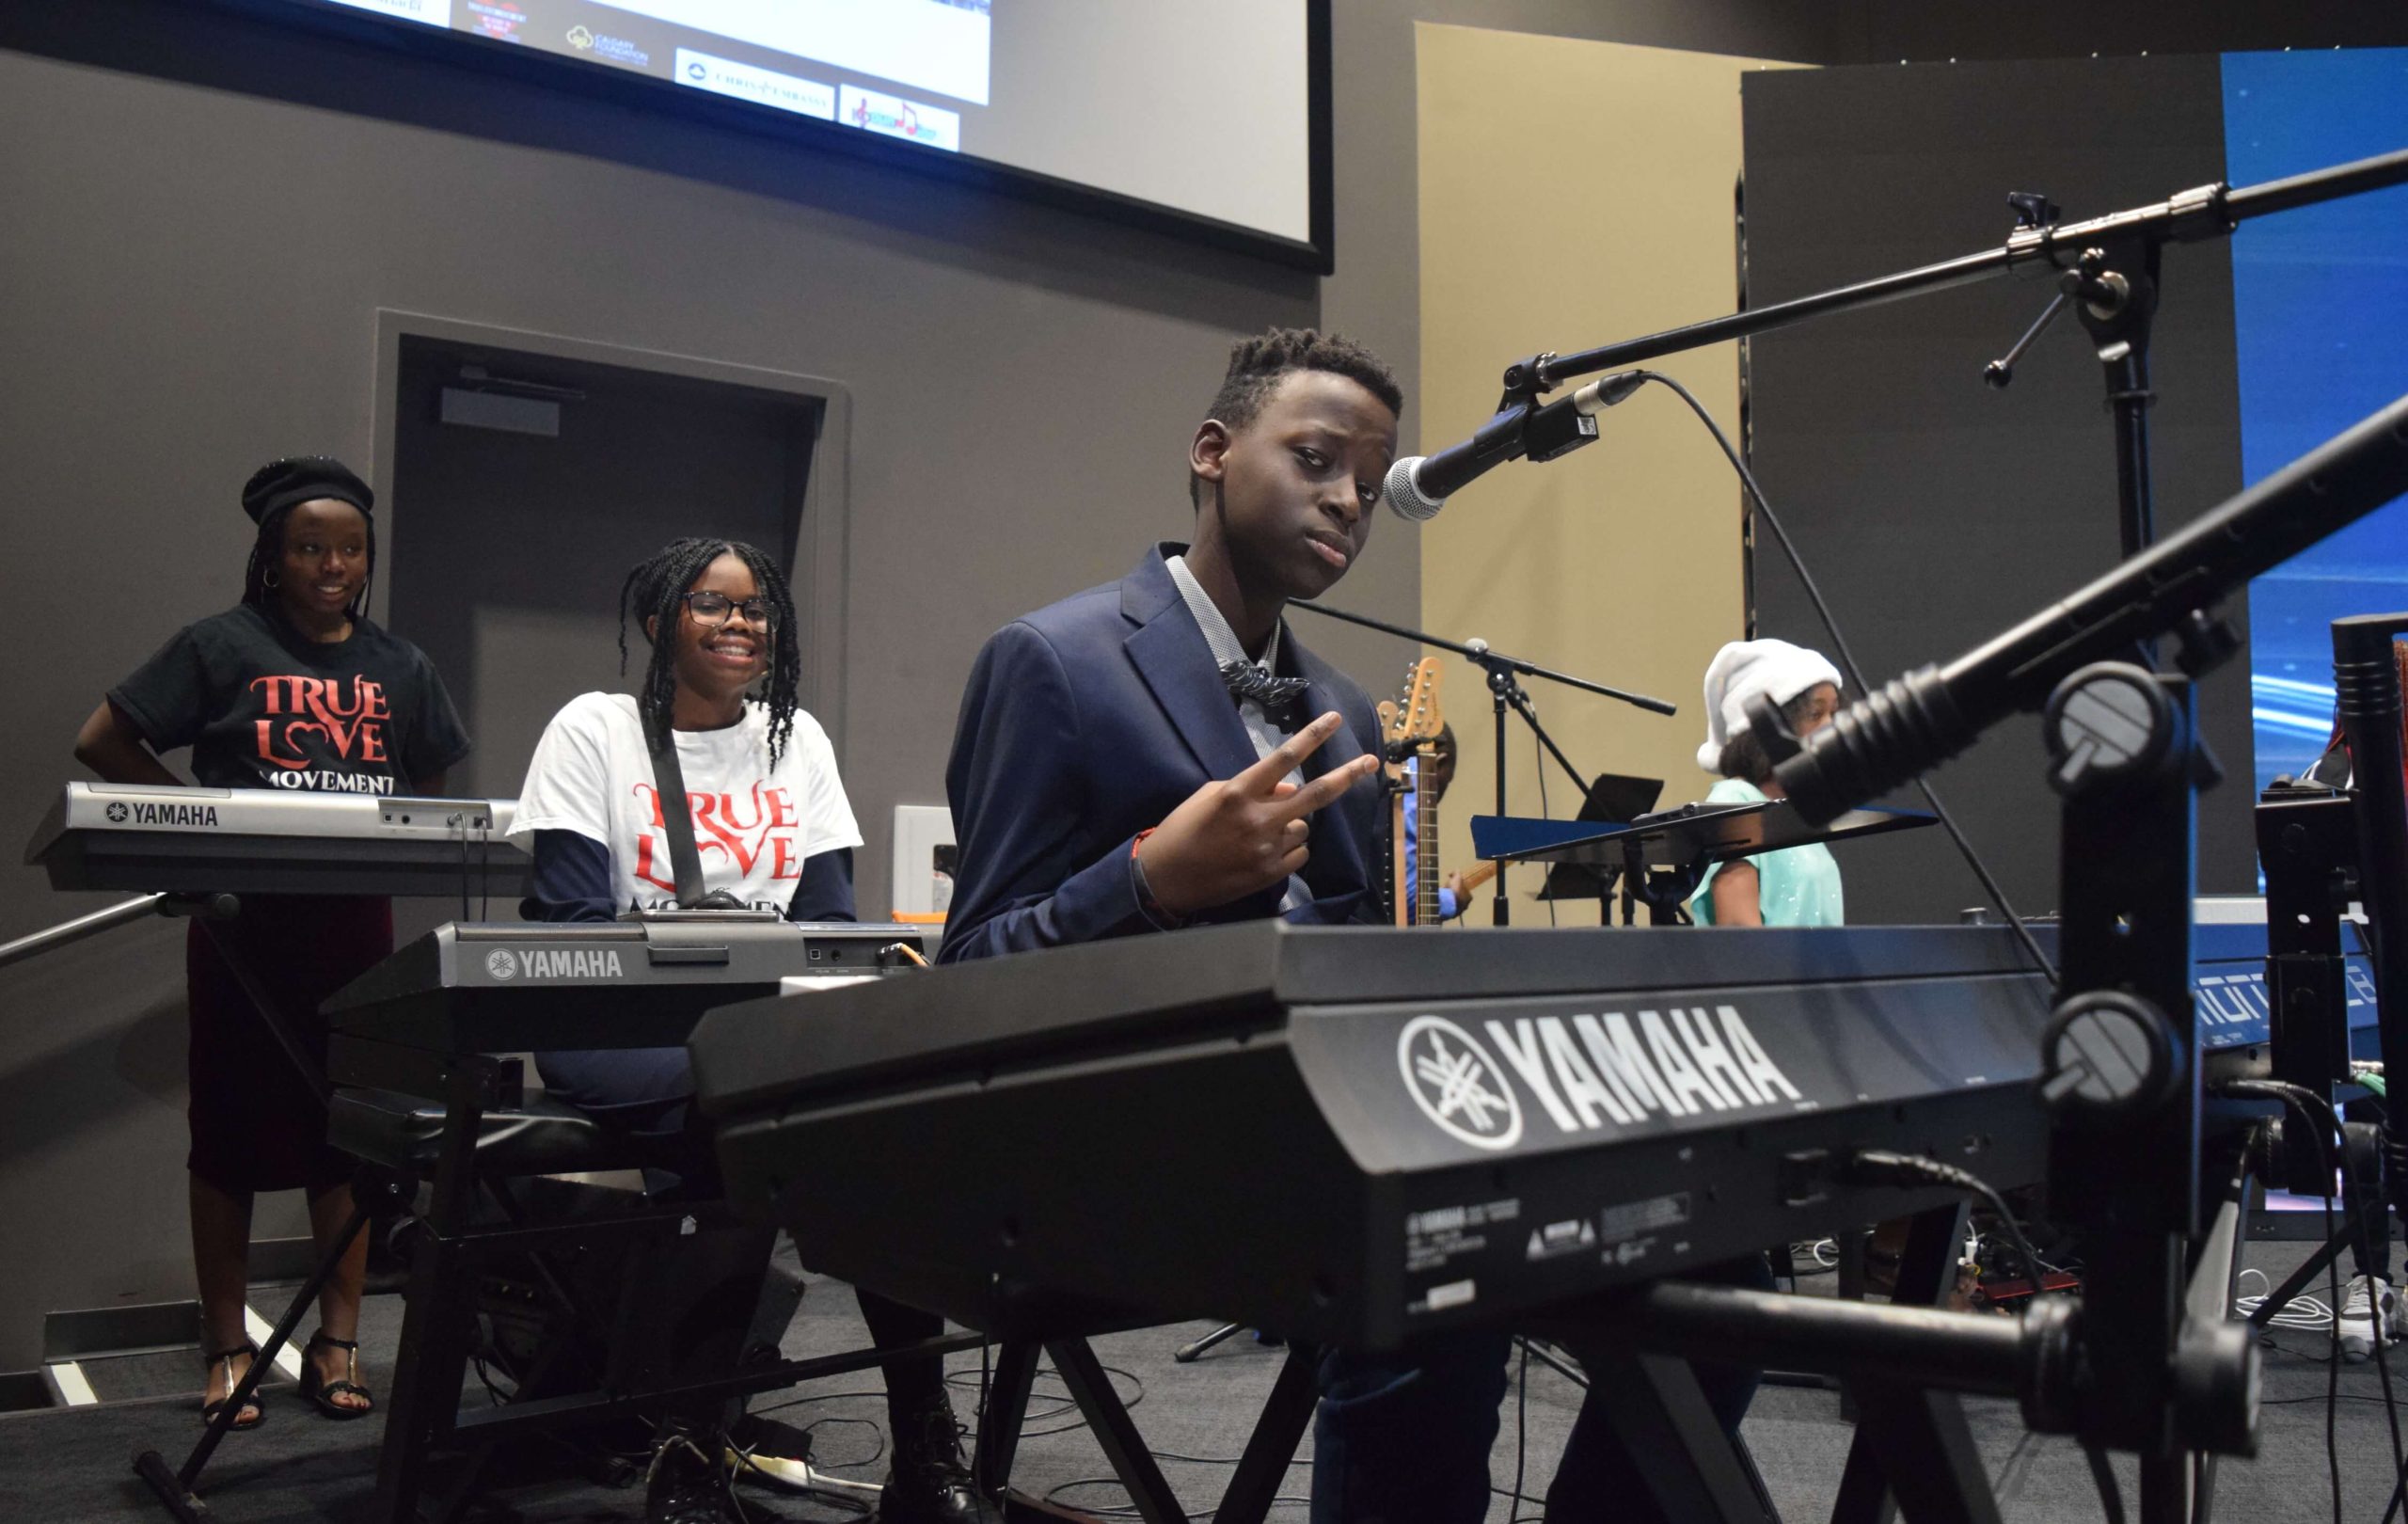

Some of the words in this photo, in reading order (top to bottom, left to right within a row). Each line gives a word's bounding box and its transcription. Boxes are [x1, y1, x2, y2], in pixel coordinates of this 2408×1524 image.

[249, 674, 390, 722] TRUE
[133, 802, 218, 827] YAMAHA
[518, 950, 624, 978] YAMAHA
[1484, 1005, 1802, 1133] YAMAHA
